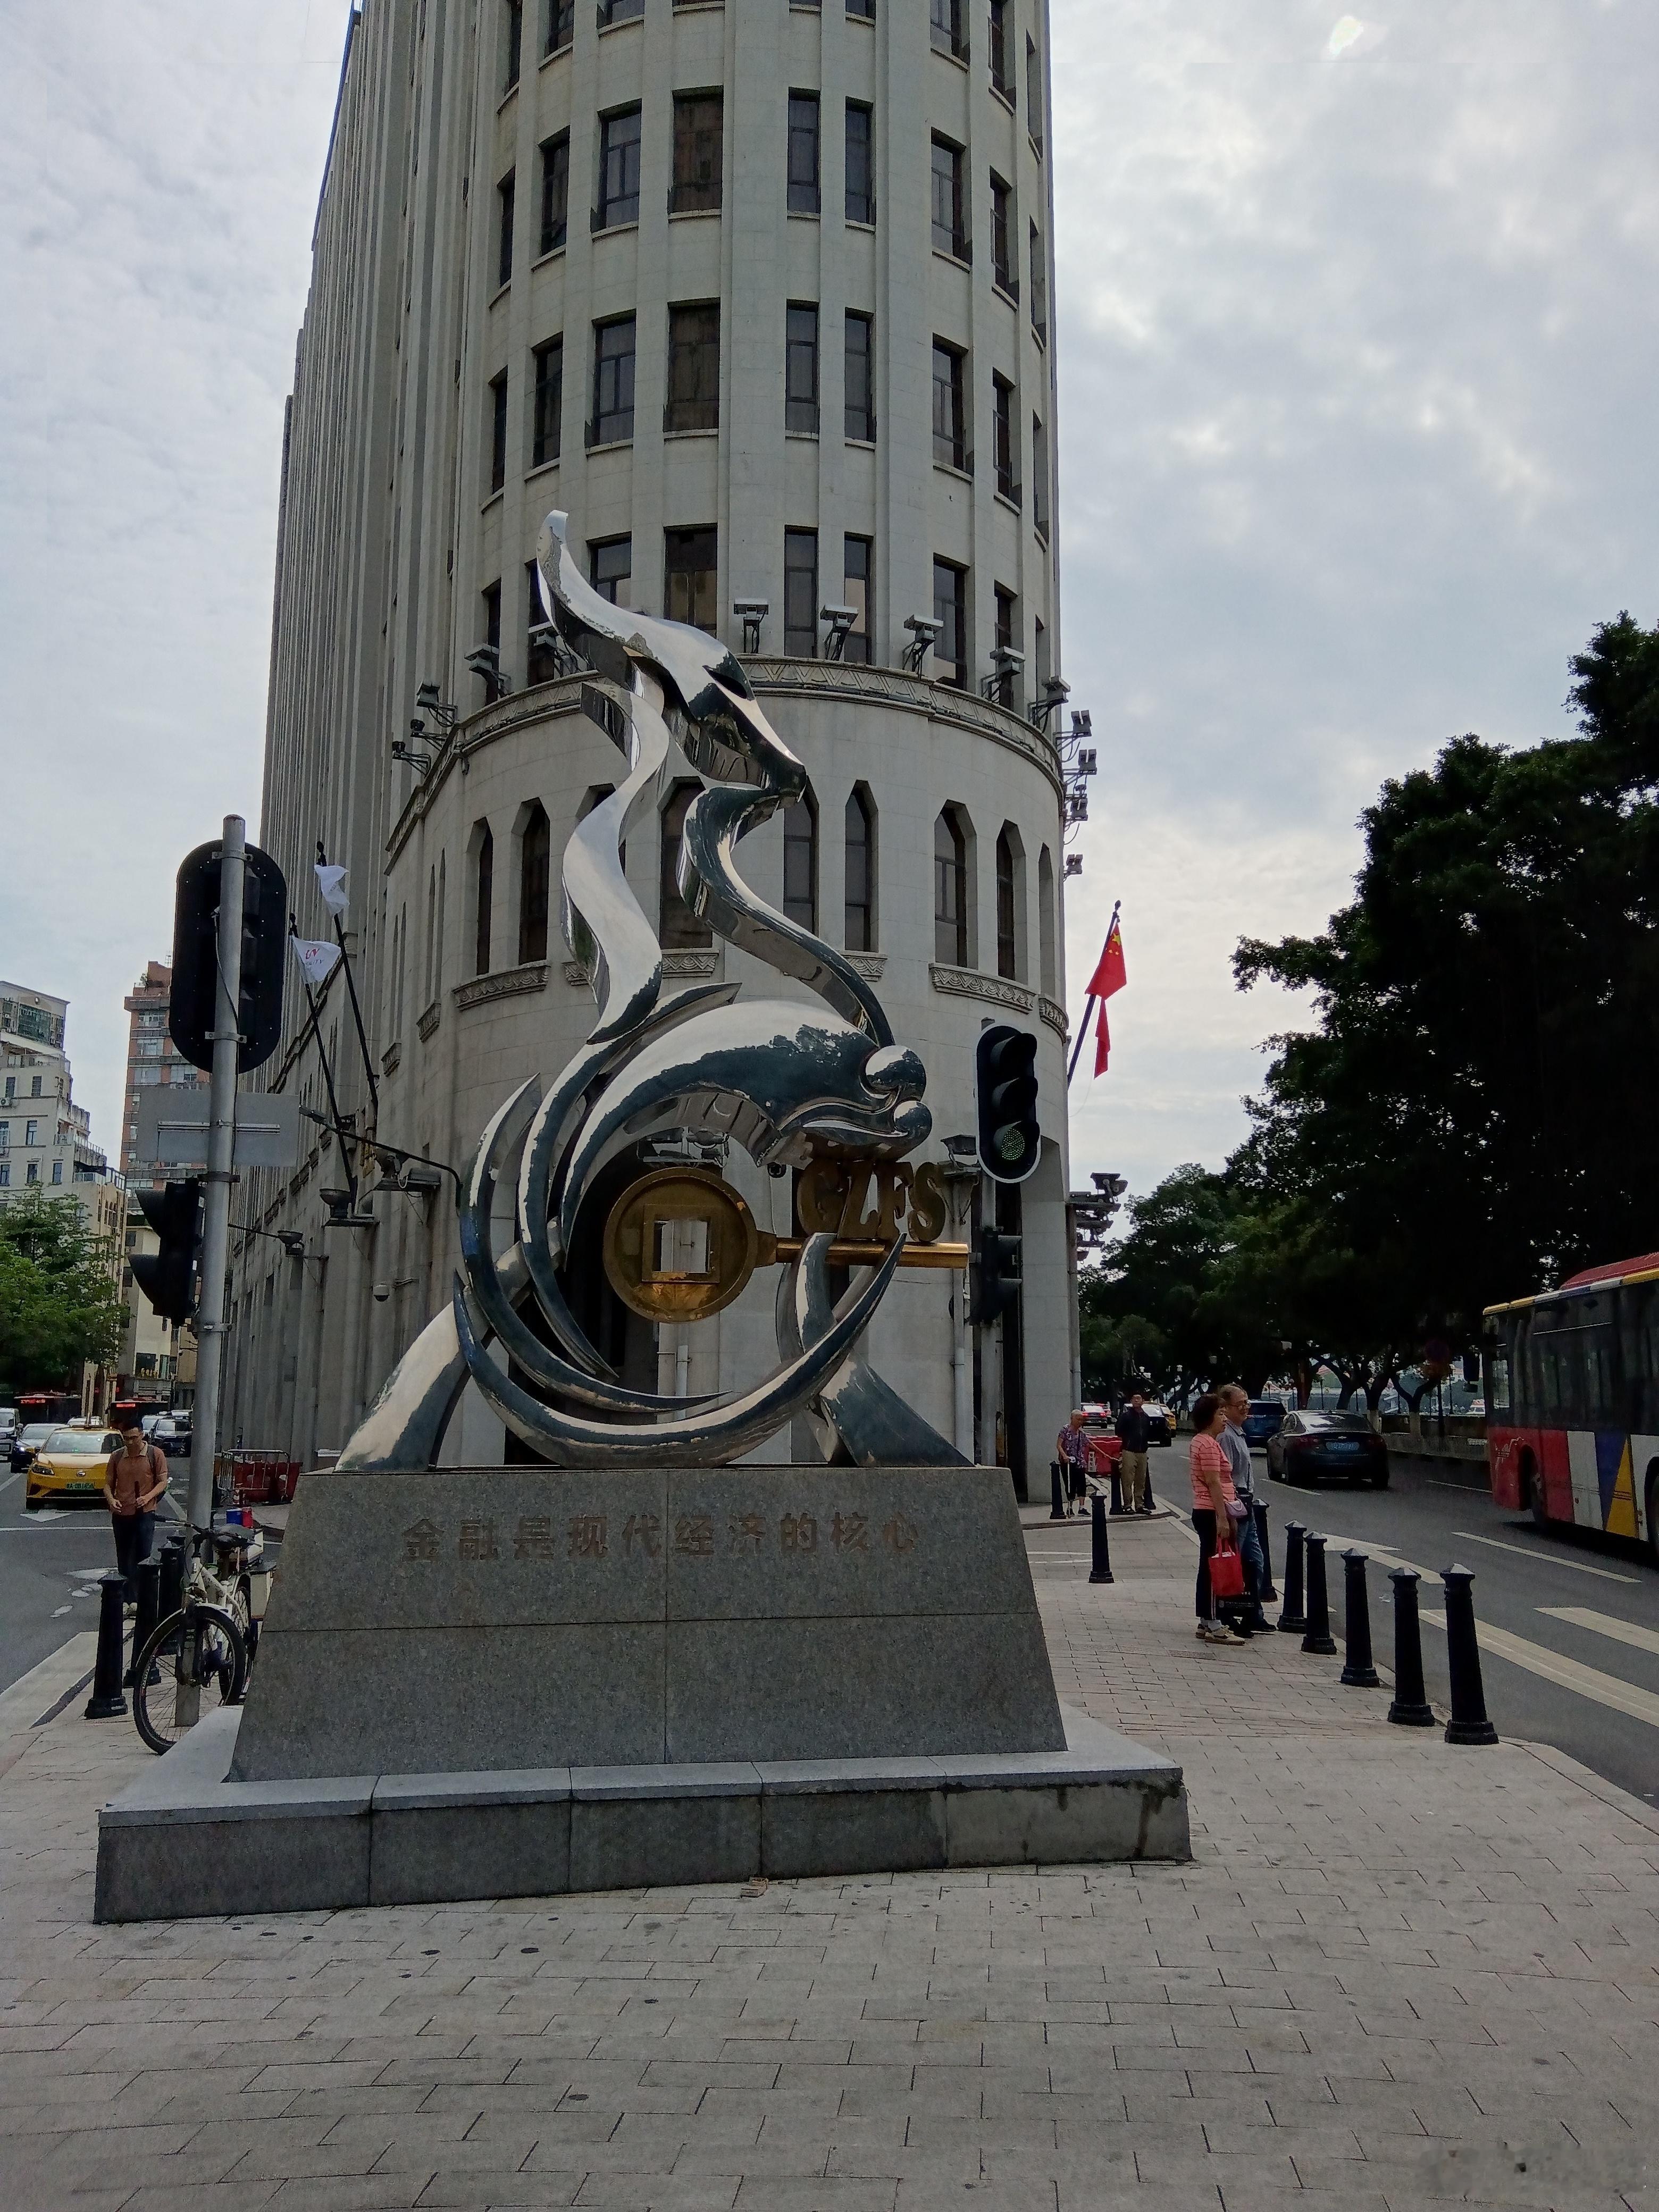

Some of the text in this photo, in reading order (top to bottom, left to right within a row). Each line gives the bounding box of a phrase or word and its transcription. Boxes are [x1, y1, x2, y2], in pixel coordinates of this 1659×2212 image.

[400, 1511, 920, 1562] 金融是现代经济的核心
